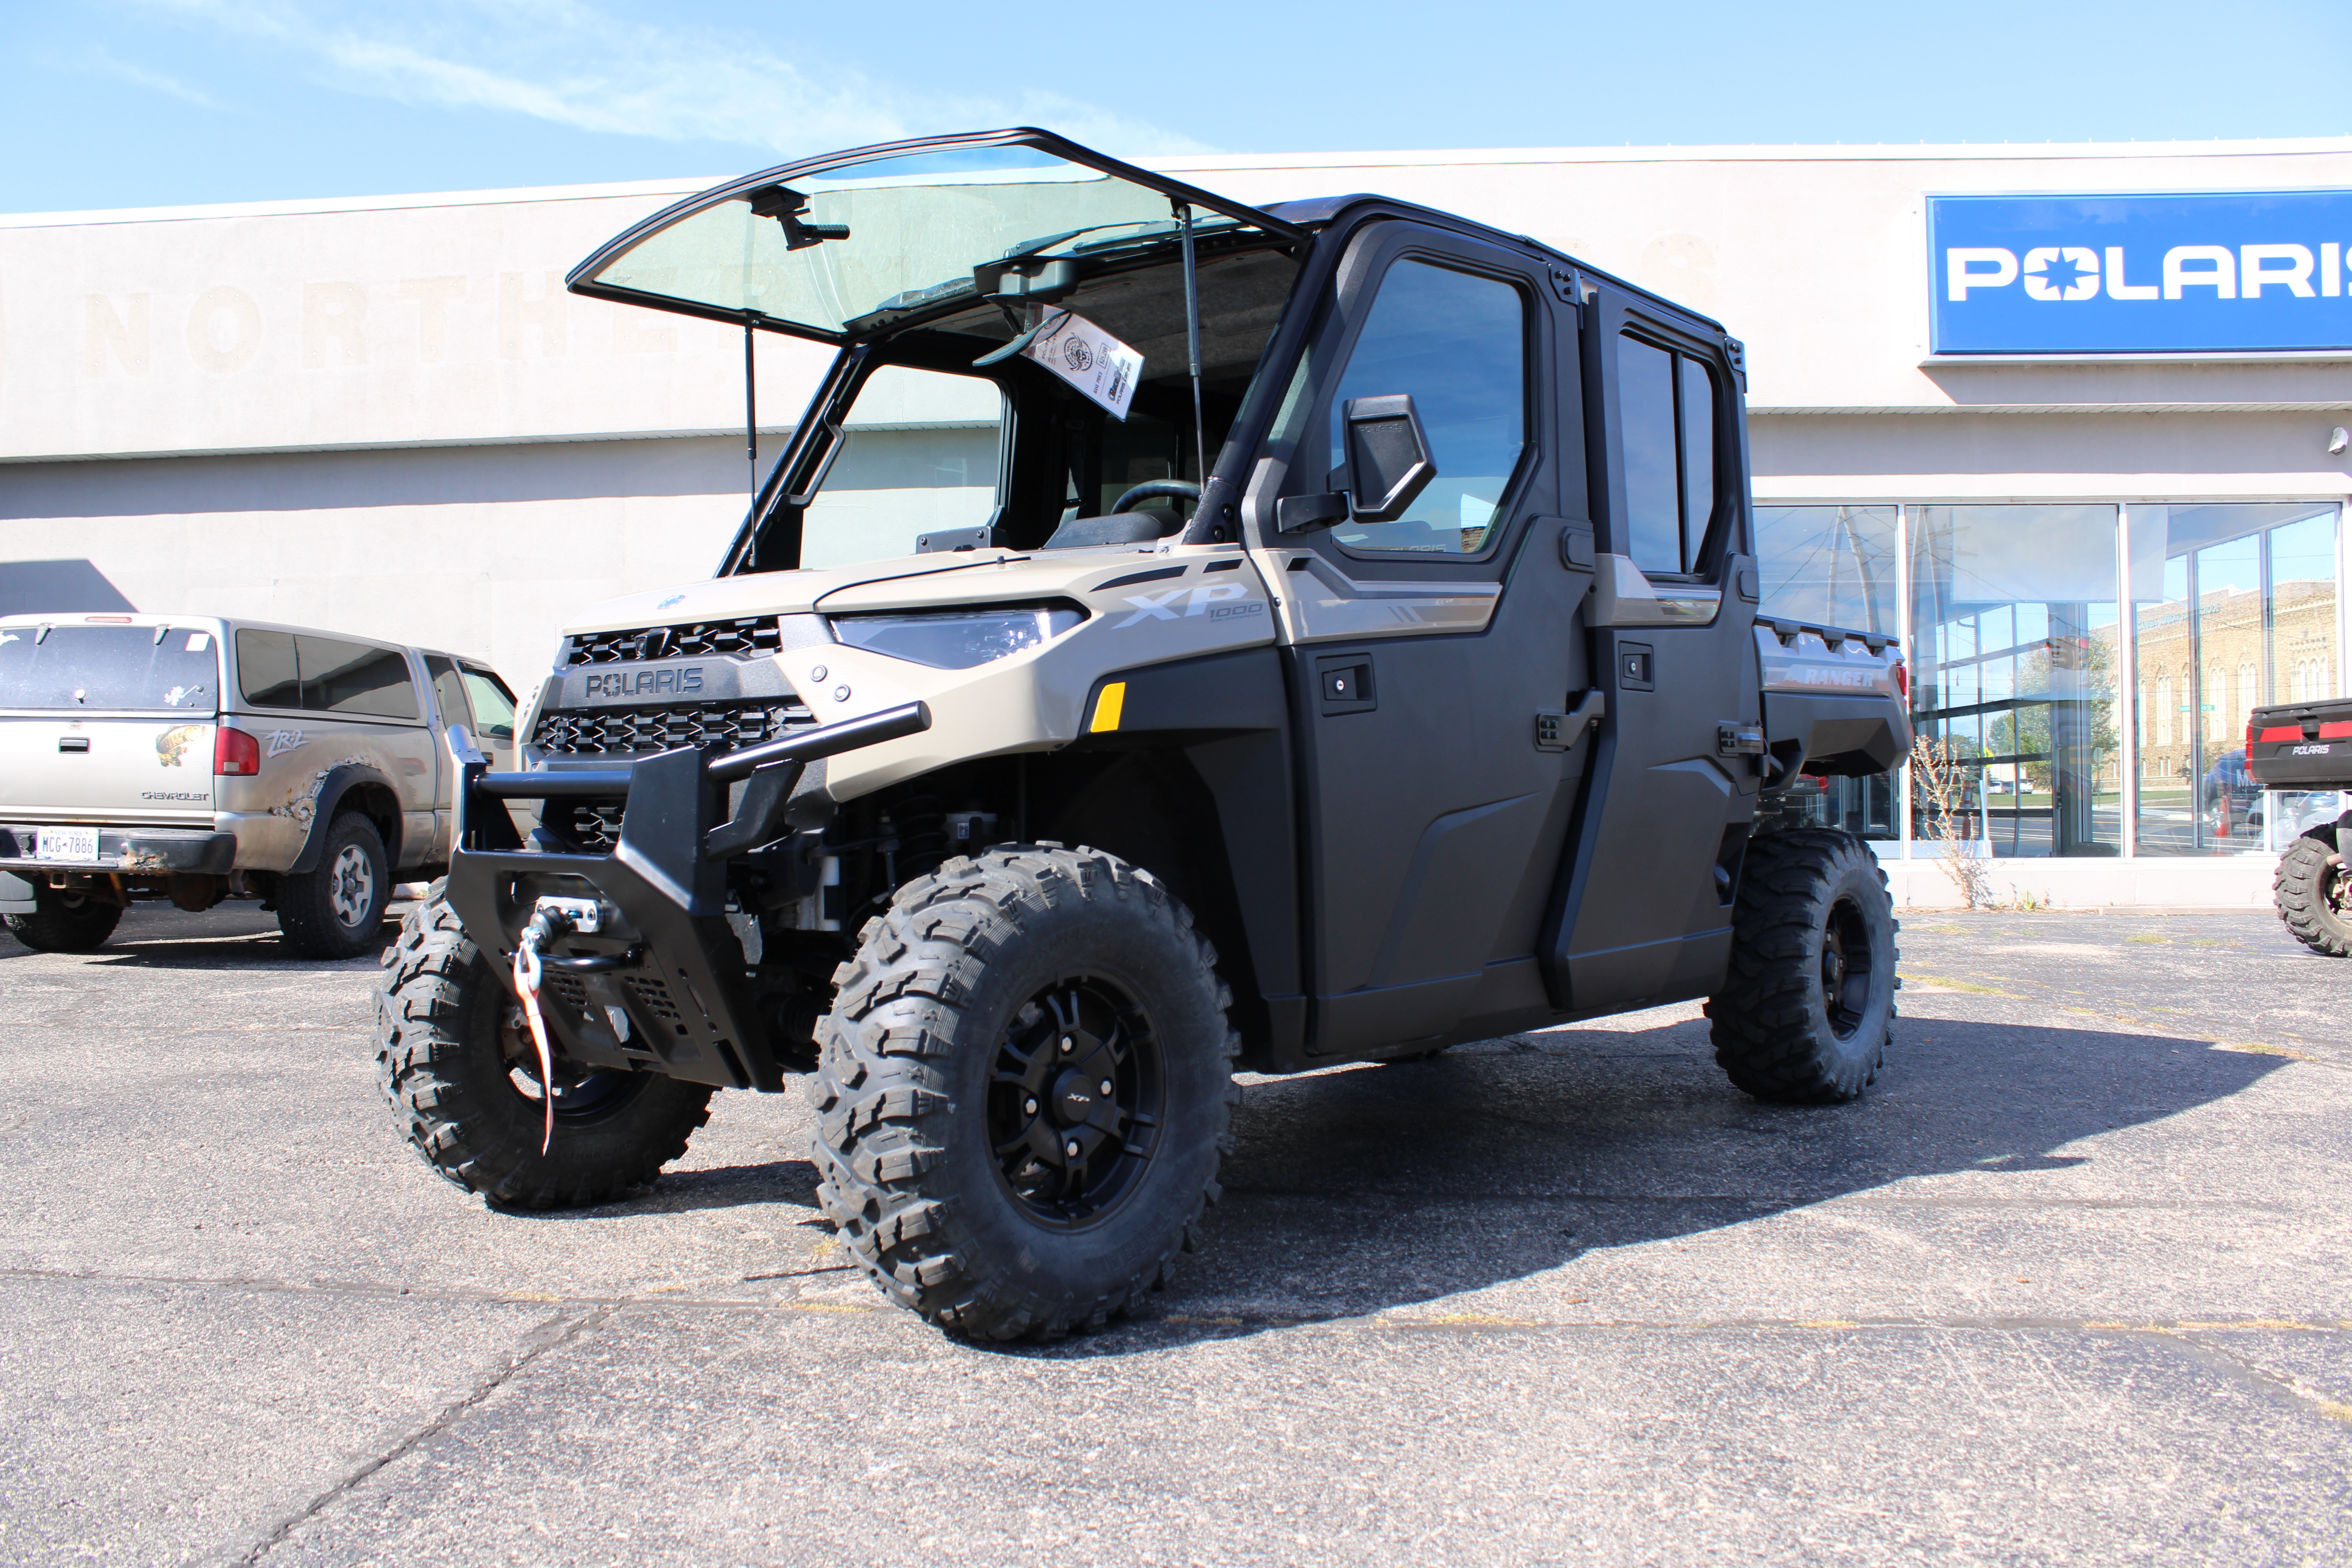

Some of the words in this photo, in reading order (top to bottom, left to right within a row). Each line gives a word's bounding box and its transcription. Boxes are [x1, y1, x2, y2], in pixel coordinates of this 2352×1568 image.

[1947, 243, 2352, 301] POLARI
[1116, 382, 1126, 405] POLARIS
[1110, 582, 1248, 630] XP
[1210, 604, 1263, 618] 1000
[2200, 604, 2221, 616] CHOOL
[585, 667, 704, 699] POLARIS
[1804, 668, 1874, 687] RANGER
[2292, 745, 2330, 756] POLARIS
[141, 791, 210, 801] CHEVROLET
[1067, 1092, 1091, 1102] XP
